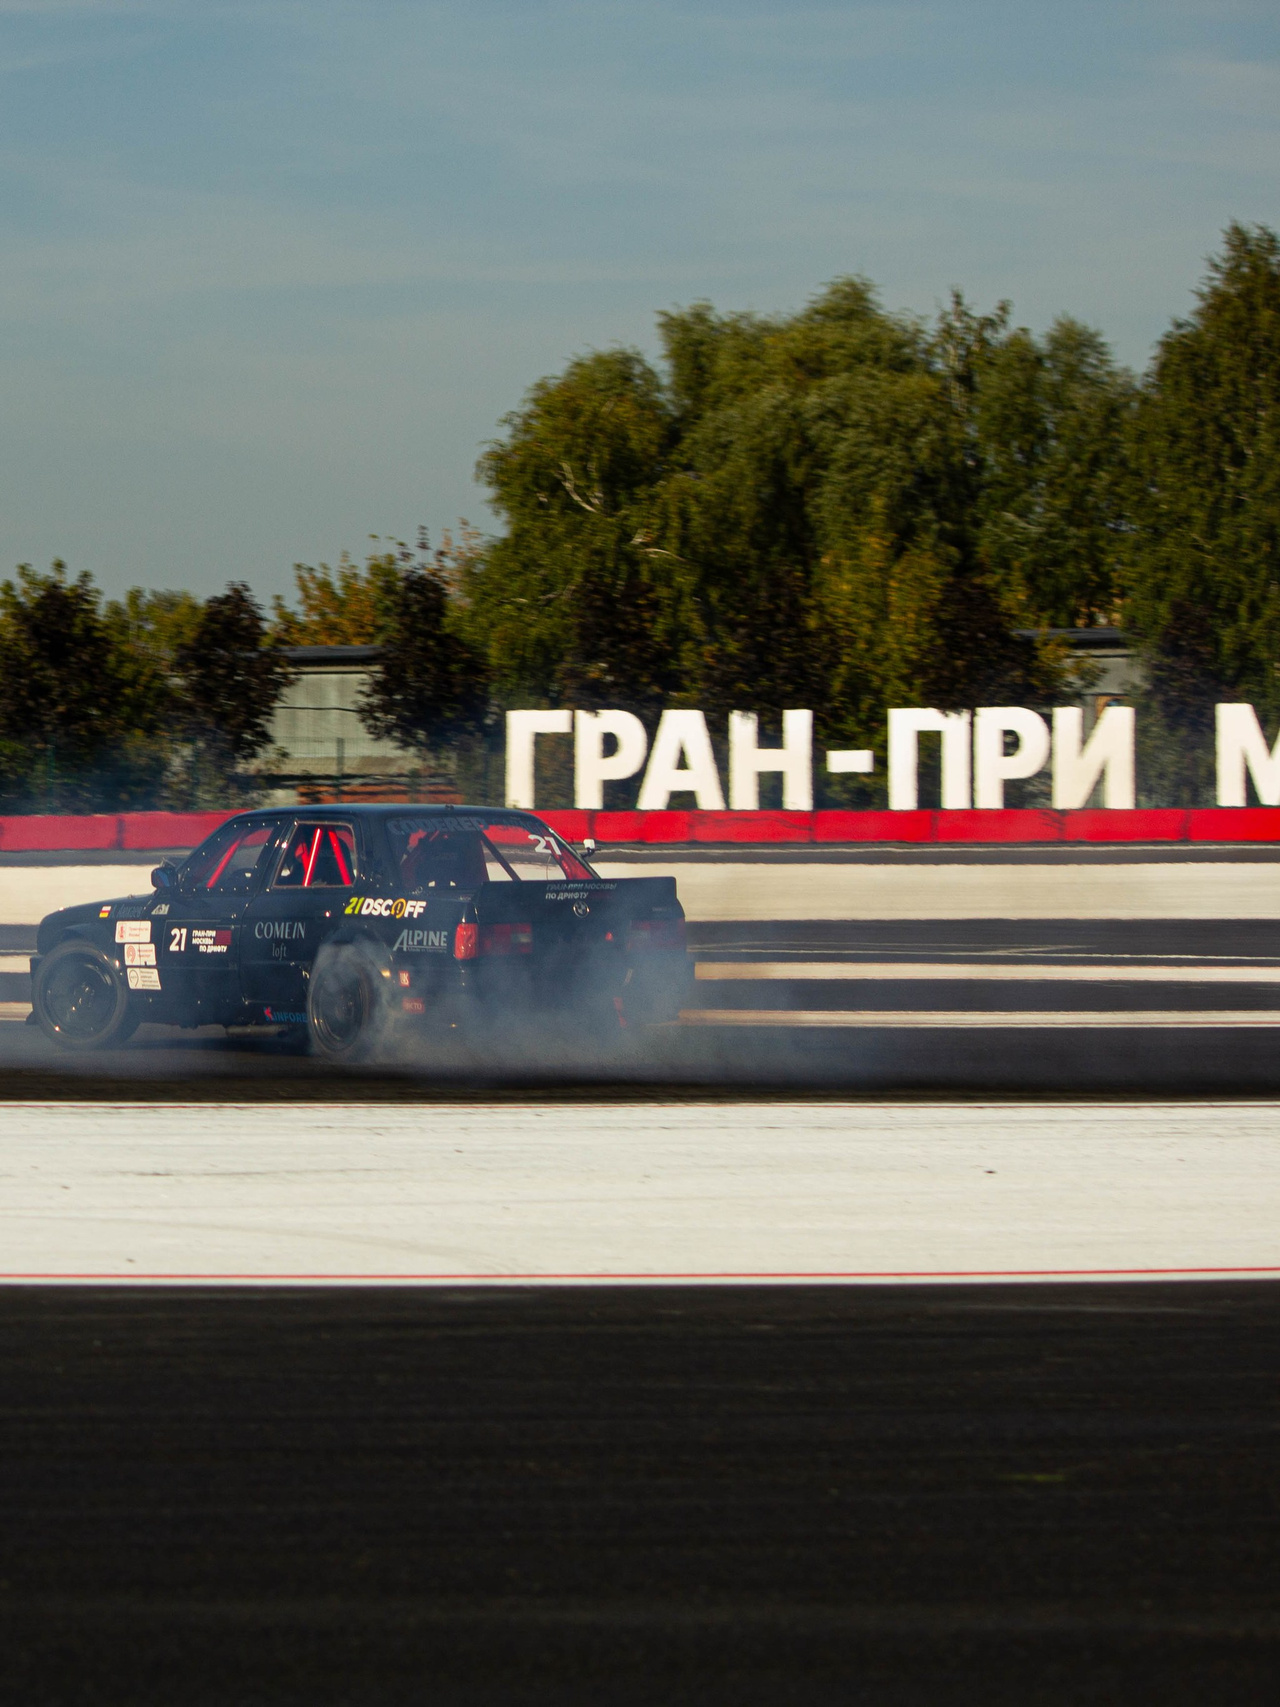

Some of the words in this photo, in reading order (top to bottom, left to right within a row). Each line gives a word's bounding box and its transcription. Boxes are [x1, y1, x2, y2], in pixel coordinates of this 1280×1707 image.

[504, 706, 1136, 810] ГРАН-ПРИ
[528, 834, 562, 856] 21
[545, 892, 557, 900] ПО
[557, 892, 589, 900] ДРИФТУ
[169, 928, 188, 952] 21
[206, 945, 228, 953] ДРИФТУ
[392, 929, 448, 951] ALPINE
